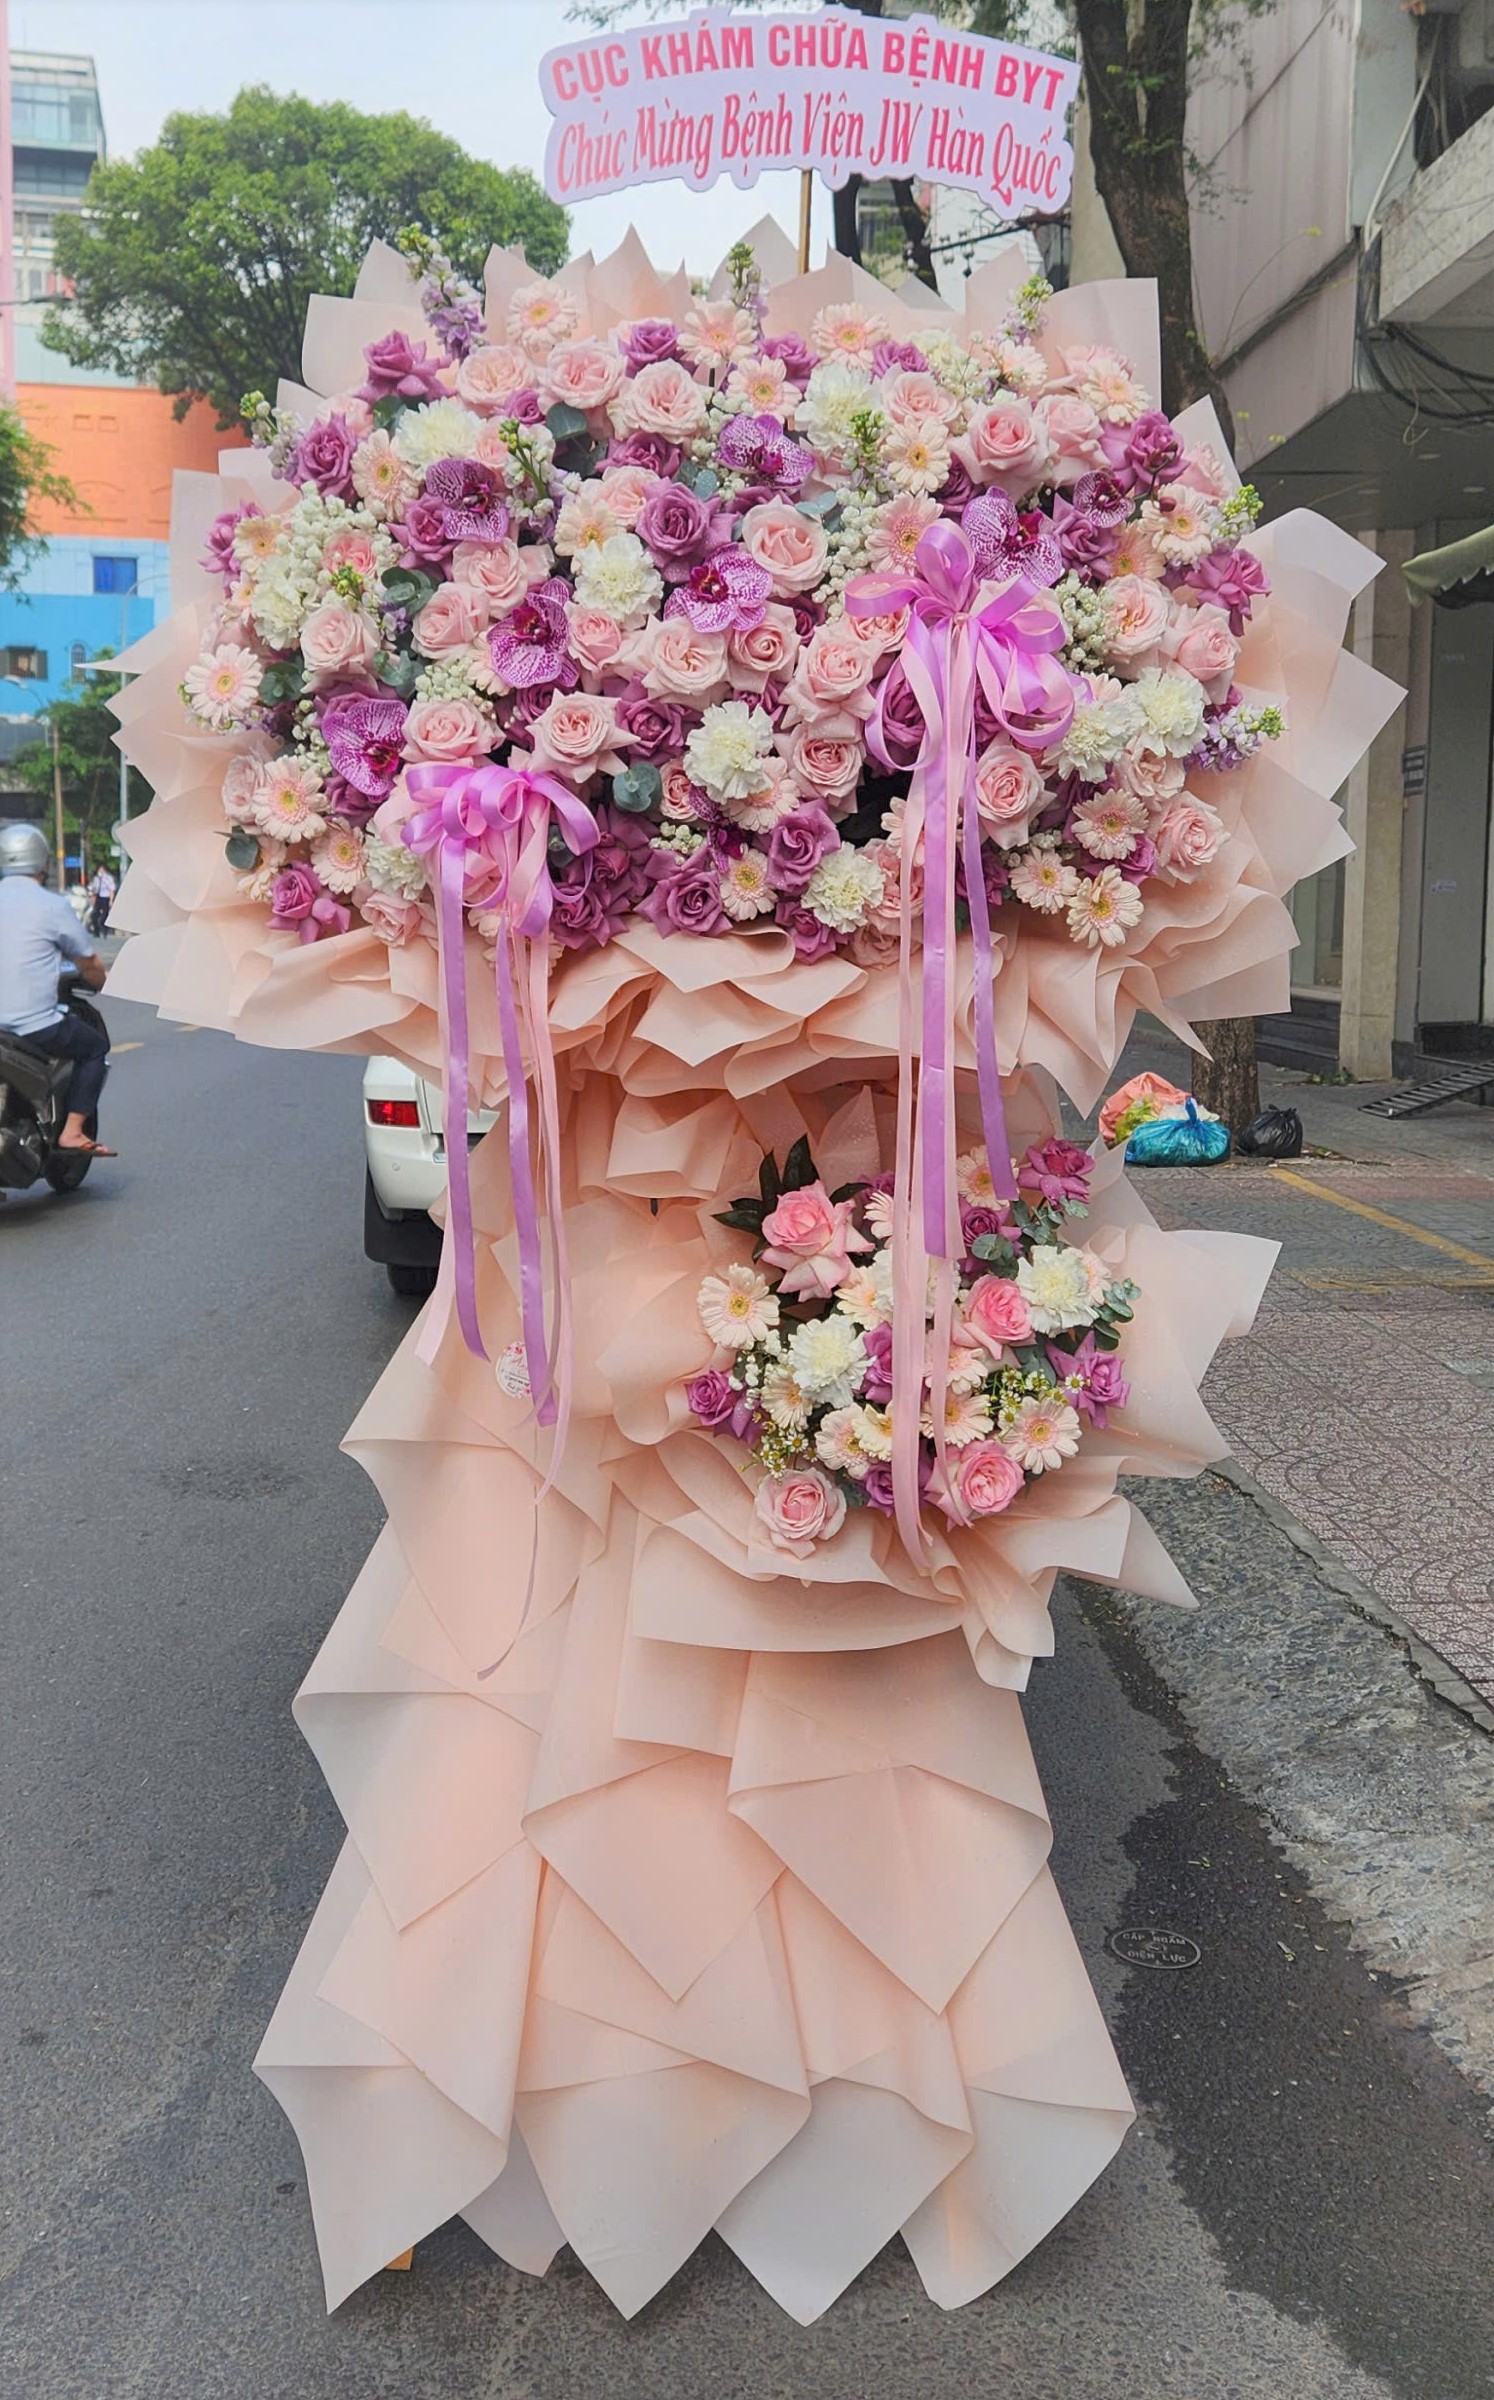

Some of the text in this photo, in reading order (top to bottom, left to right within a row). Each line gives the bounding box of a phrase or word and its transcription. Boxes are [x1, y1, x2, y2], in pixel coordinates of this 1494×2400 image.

[552, 18, 1065, 112] CỤC KHÁM CHỮA BỆNH BYT
[556, 91, 1062, 207] Chúc Mừng Bệnh Viện JW Hàn Quốc
